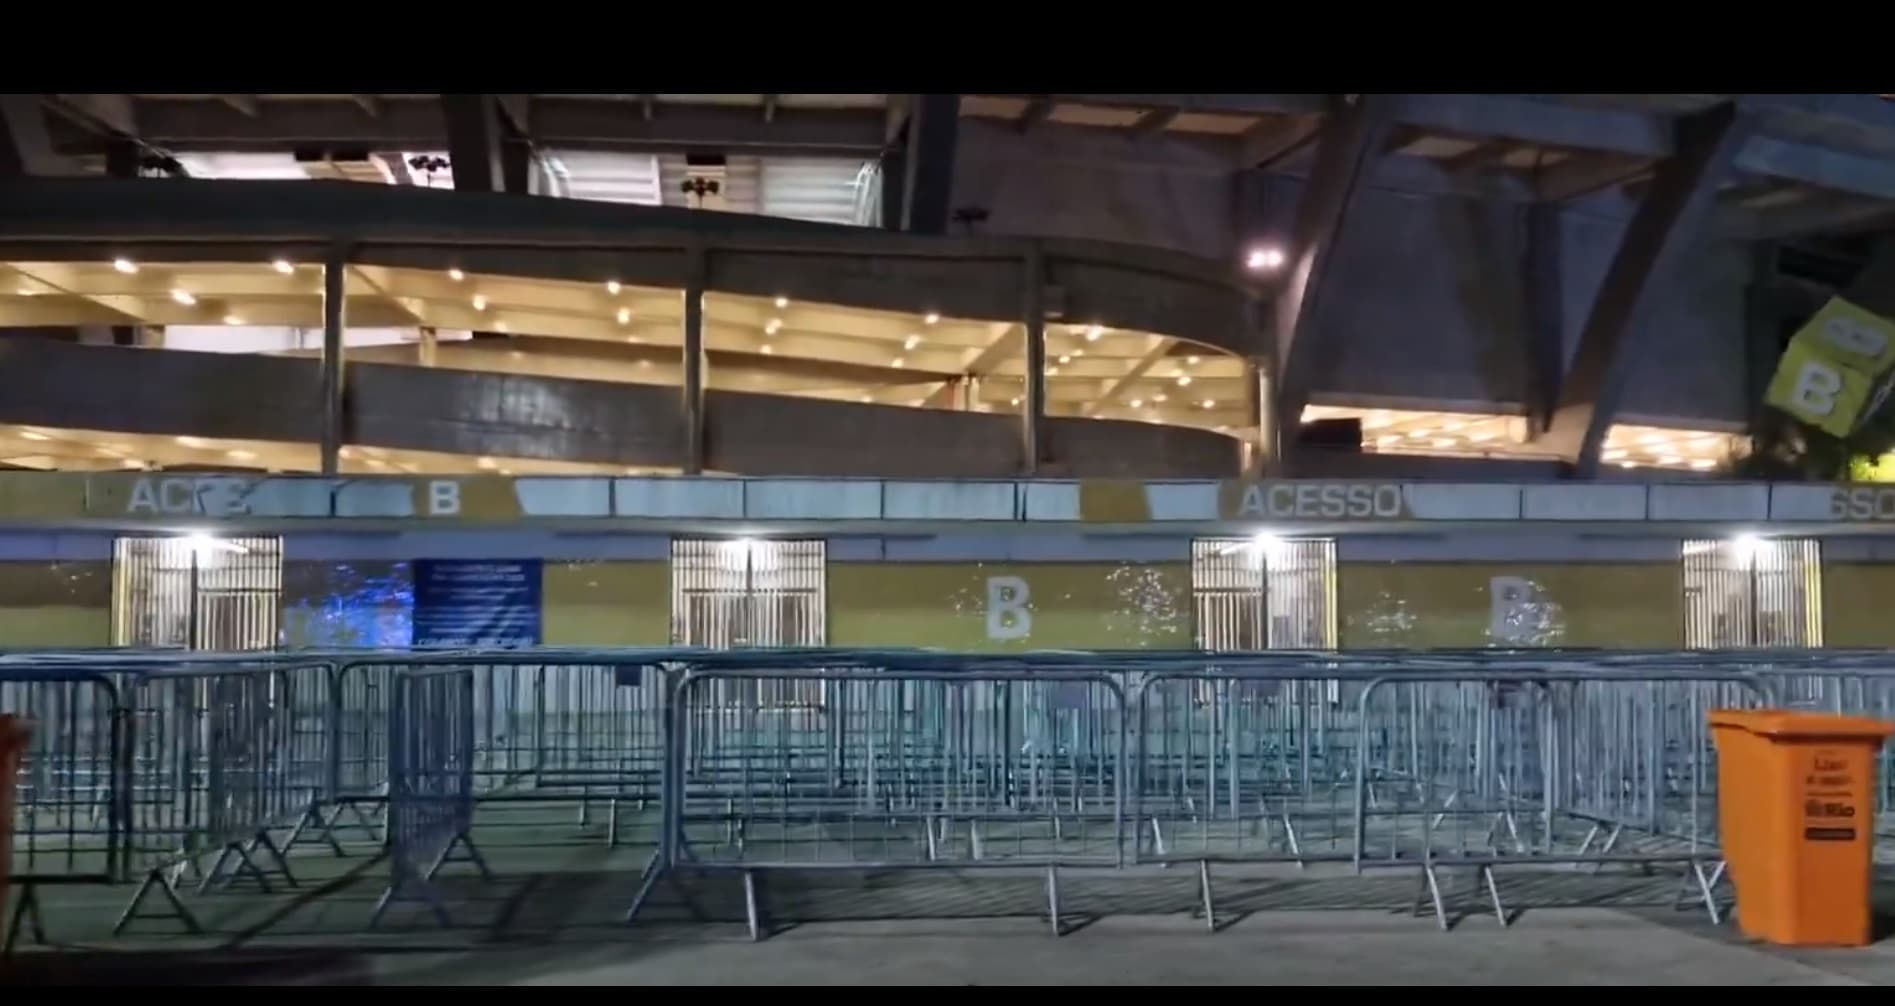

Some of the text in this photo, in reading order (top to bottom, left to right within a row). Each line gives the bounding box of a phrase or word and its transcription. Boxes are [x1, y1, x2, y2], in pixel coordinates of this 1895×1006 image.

[1793, 362, 1841, 416] B
[429, 480, 461, 515] B
[1239, 483, 1402, 517] ACESSO
[986, 576, 1031, 638] B
[1490, 576, 1535, 638] B
